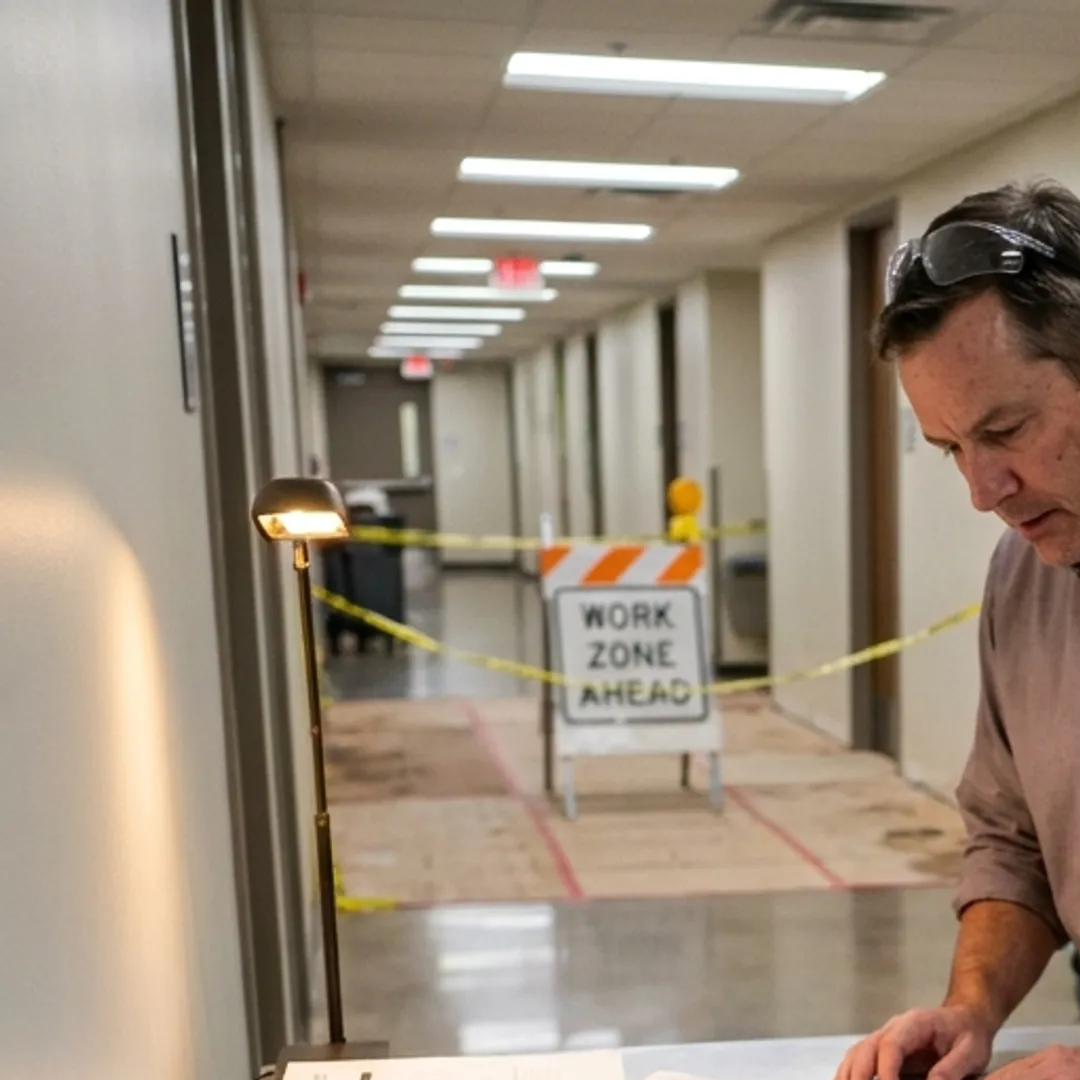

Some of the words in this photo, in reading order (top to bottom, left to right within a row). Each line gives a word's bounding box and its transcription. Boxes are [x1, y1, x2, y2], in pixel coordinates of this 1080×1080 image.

[580, 602, 675, 630] WORK
[588, 640, 676, 669] ZONE
[579, 679, 691, 707] AHEAD
